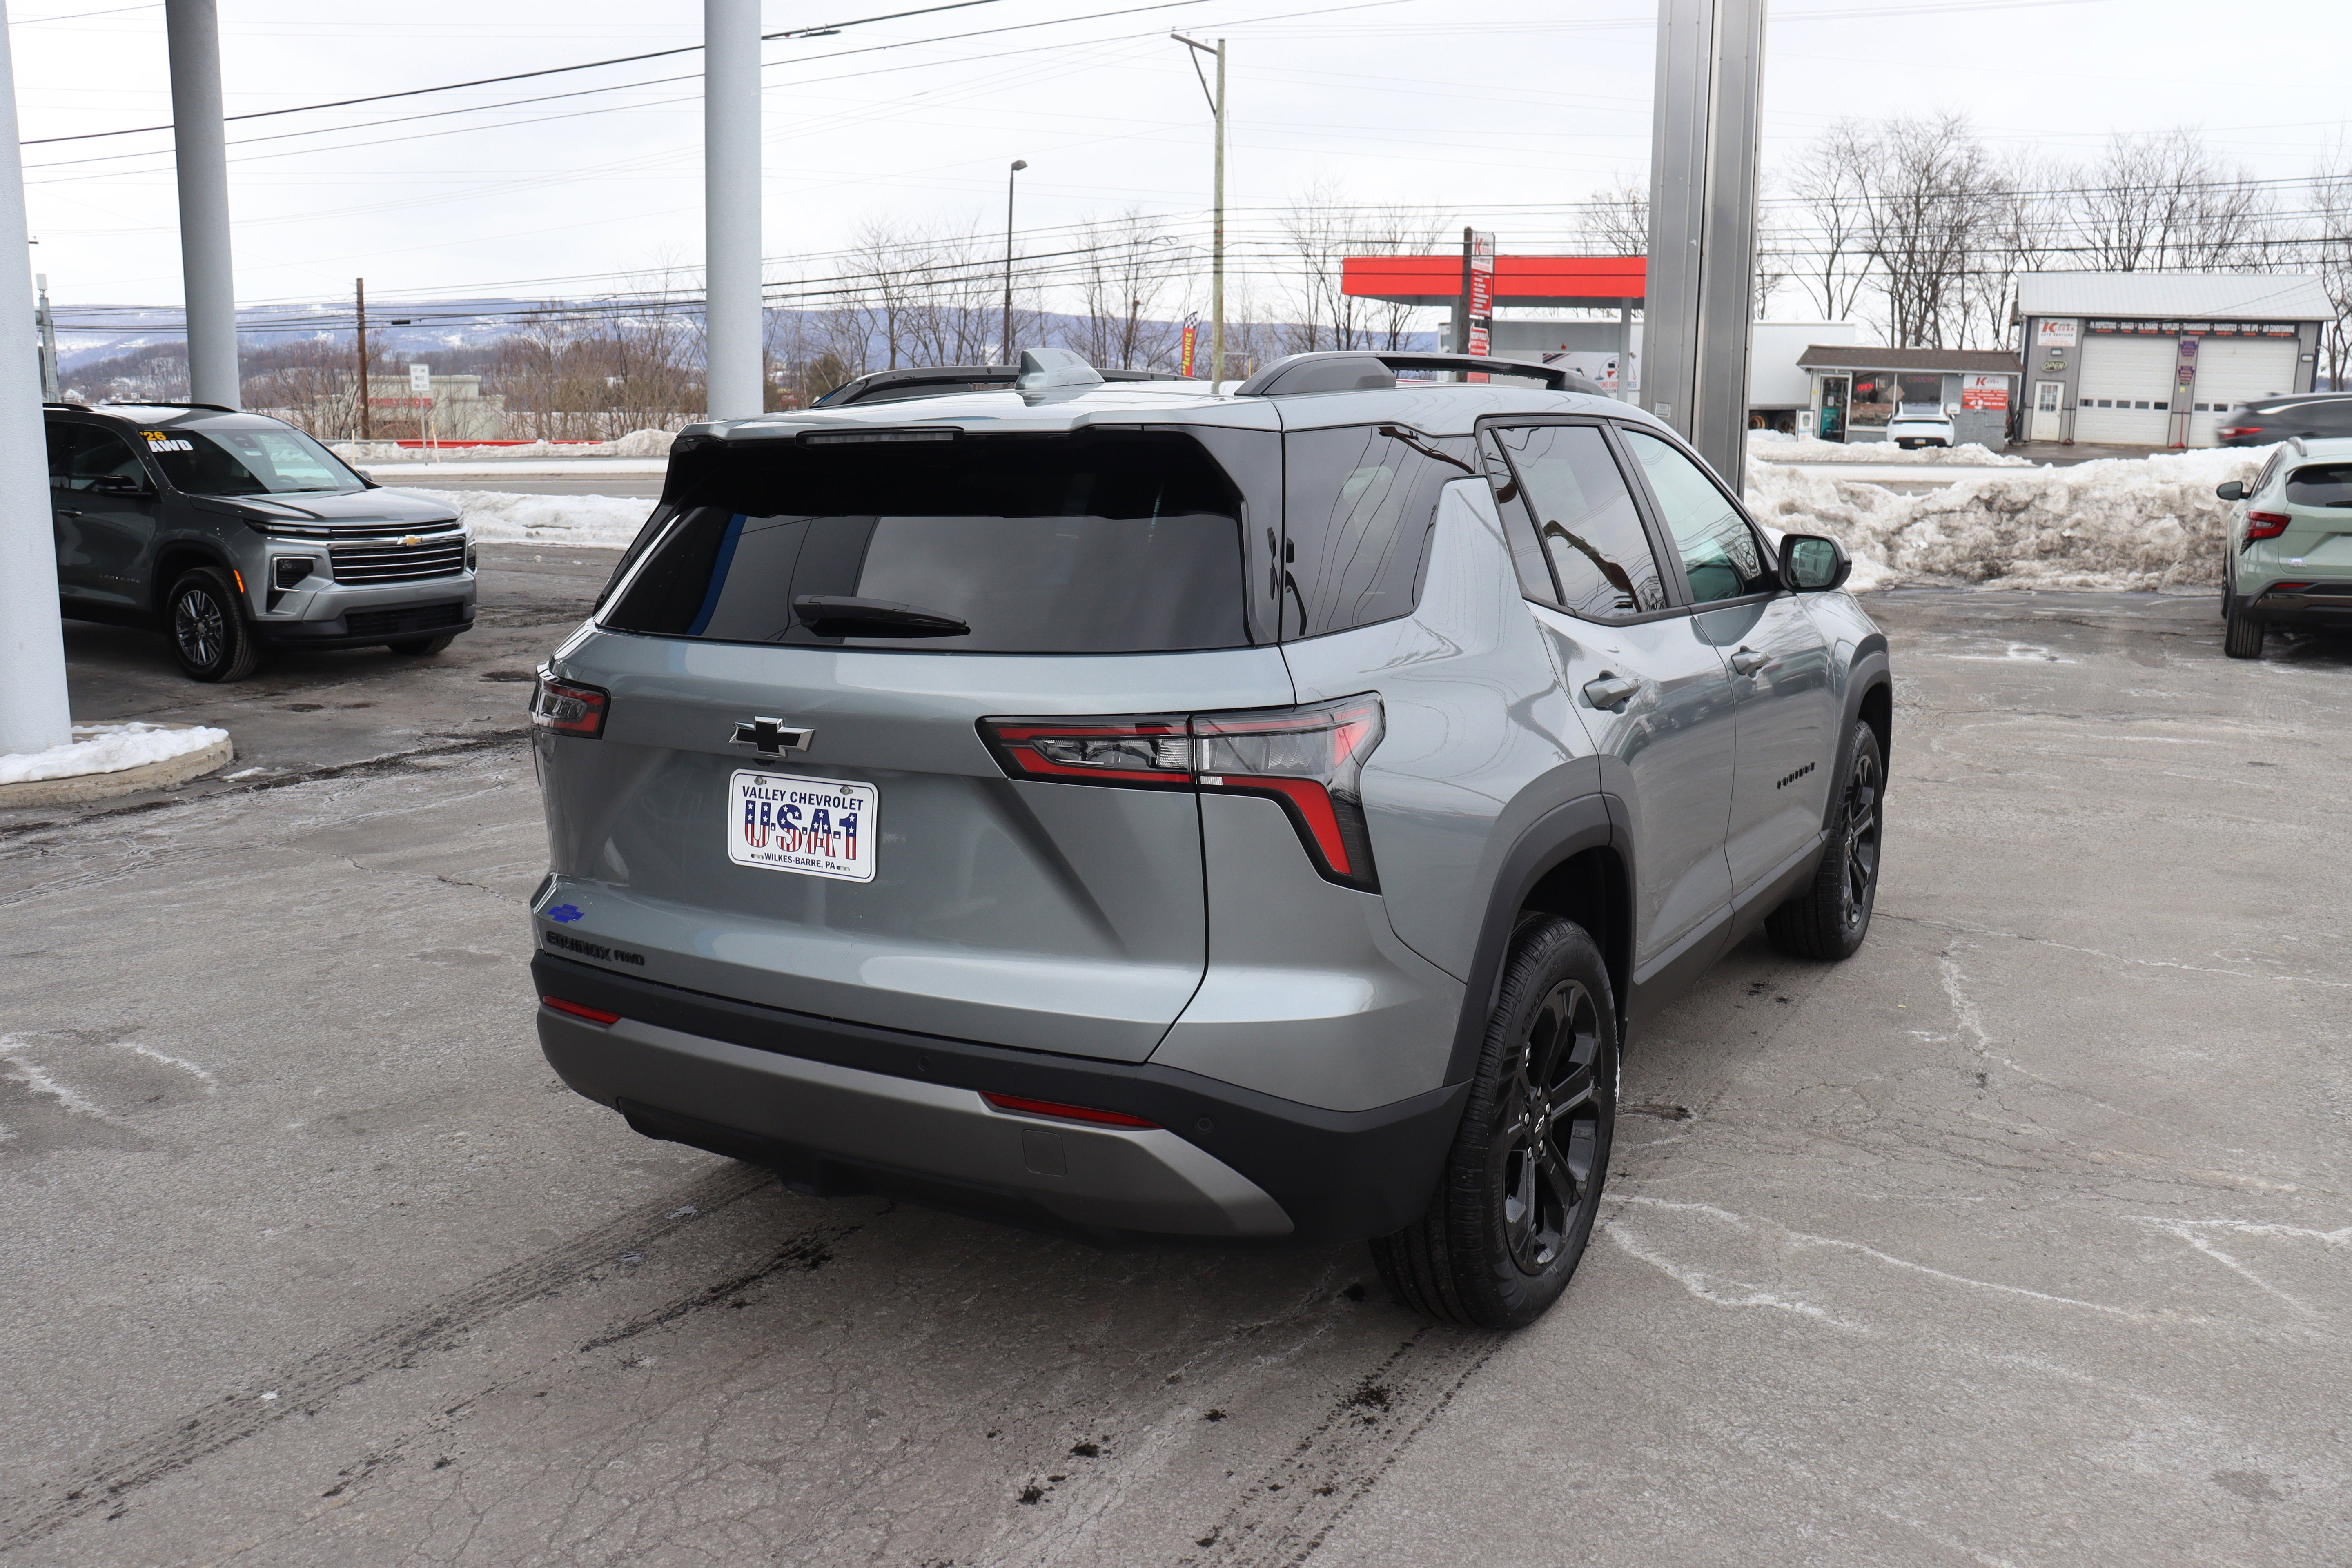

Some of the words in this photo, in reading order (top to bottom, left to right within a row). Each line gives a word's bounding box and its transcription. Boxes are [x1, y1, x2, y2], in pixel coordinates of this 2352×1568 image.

[2120, 322, 2134, 330] BRAKES
[2162, 323, 2179, 331] MUFFLERS
[2183, 323, 2210, 331] TRANSMISSIONS
[2214, 323, 2237, 332] DIAGNOSTICS
[2241, 324, 2251, 332] TUNE
[2270, 325, 2295, 333] CONDITIONING
[1182, 332, 1192, 366] SERVICE
[2043, 362, 2065, 370] OPEN
[1857, 383, 1874, 392] OPEN
[139, 431, 167, 441] '26
[147, 440, 193, 452] AWD
[742, 786, 787, 802] VALLEY
[790, 791, 864, 811] CHEVROLET
[764, 852, 823, 869] WILKES-BARRE,
[825, 861, 835, 870] PA
